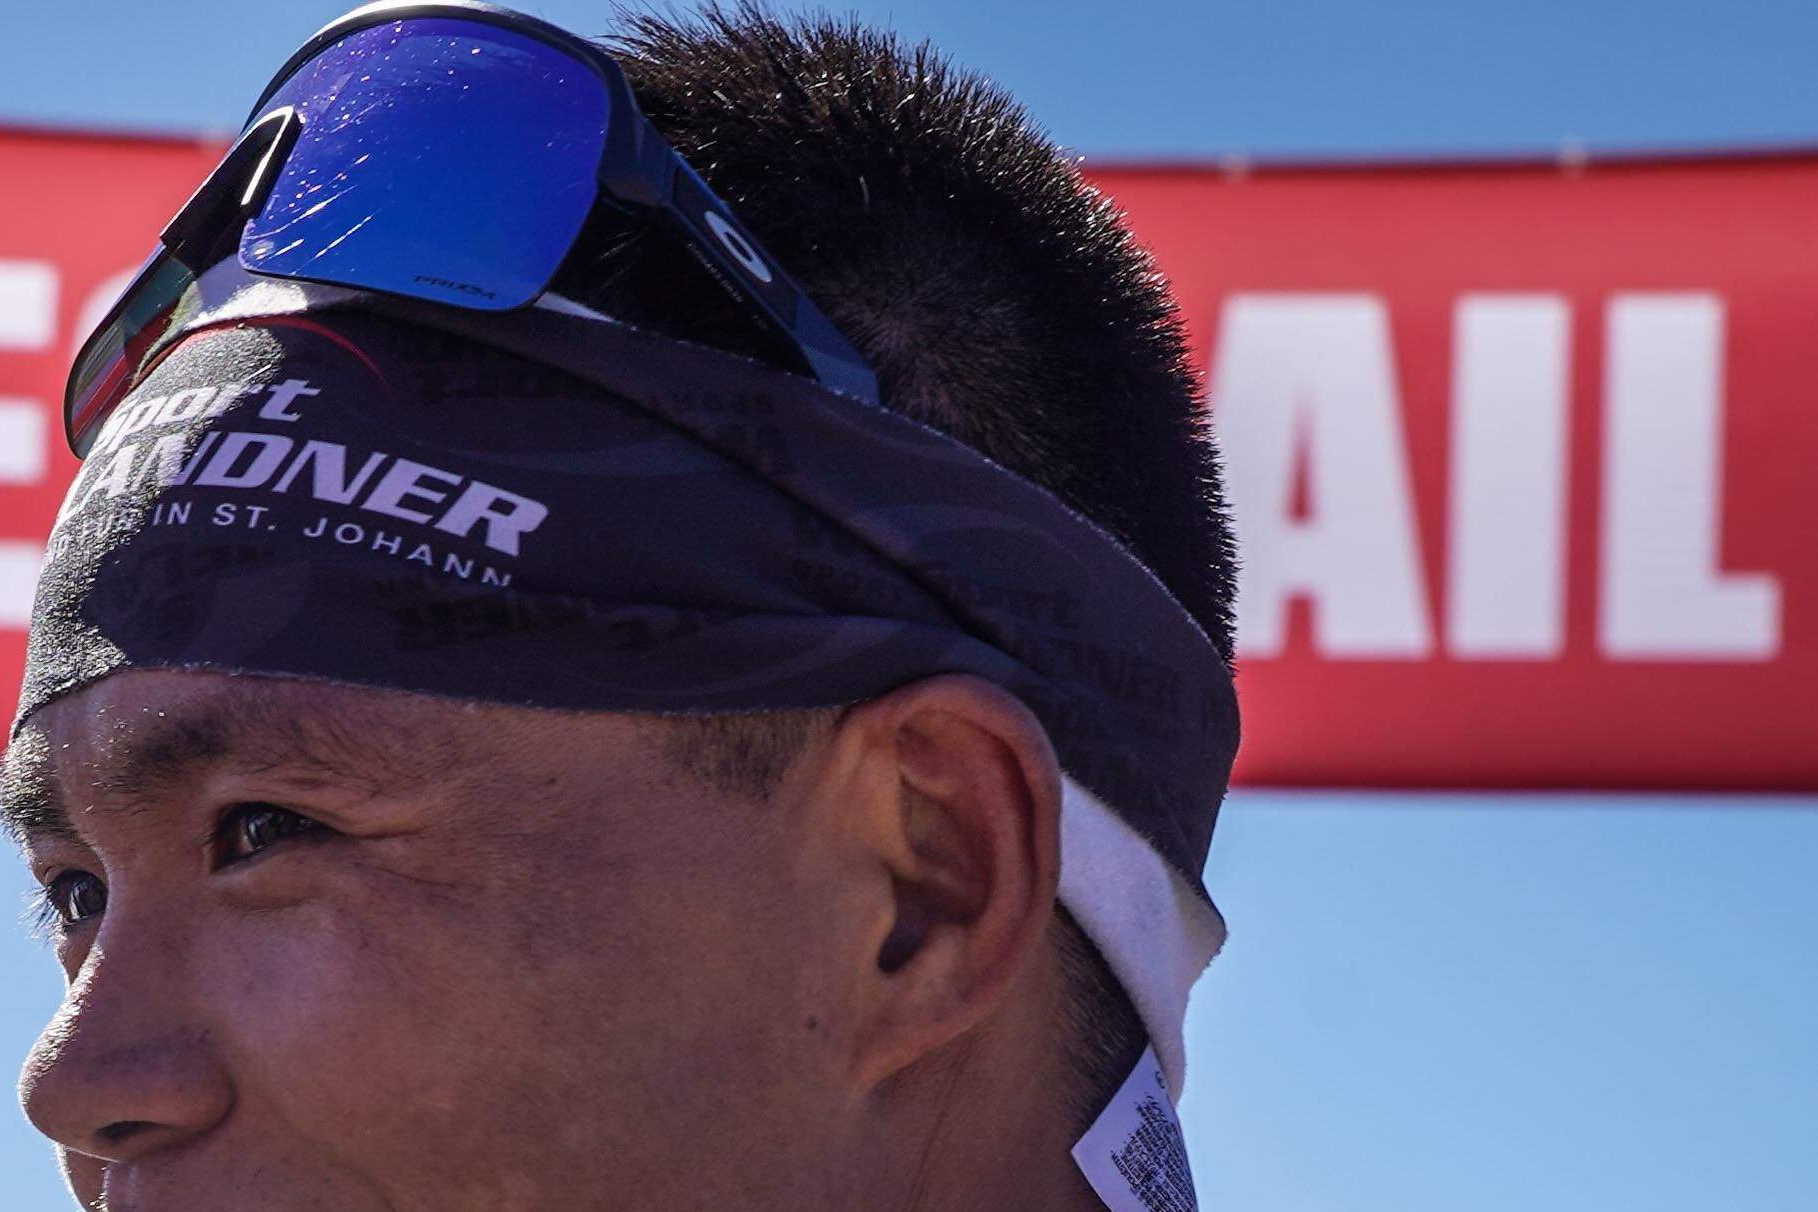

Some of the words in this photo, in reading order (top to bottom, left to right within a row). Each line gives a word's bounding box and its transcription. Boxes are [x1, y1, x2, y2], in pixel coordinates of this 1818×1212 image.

[152, 502, 192, 527] IN
[211, 502, 277, 531] ST.
[302, 516, 513, 588] JOHANN
